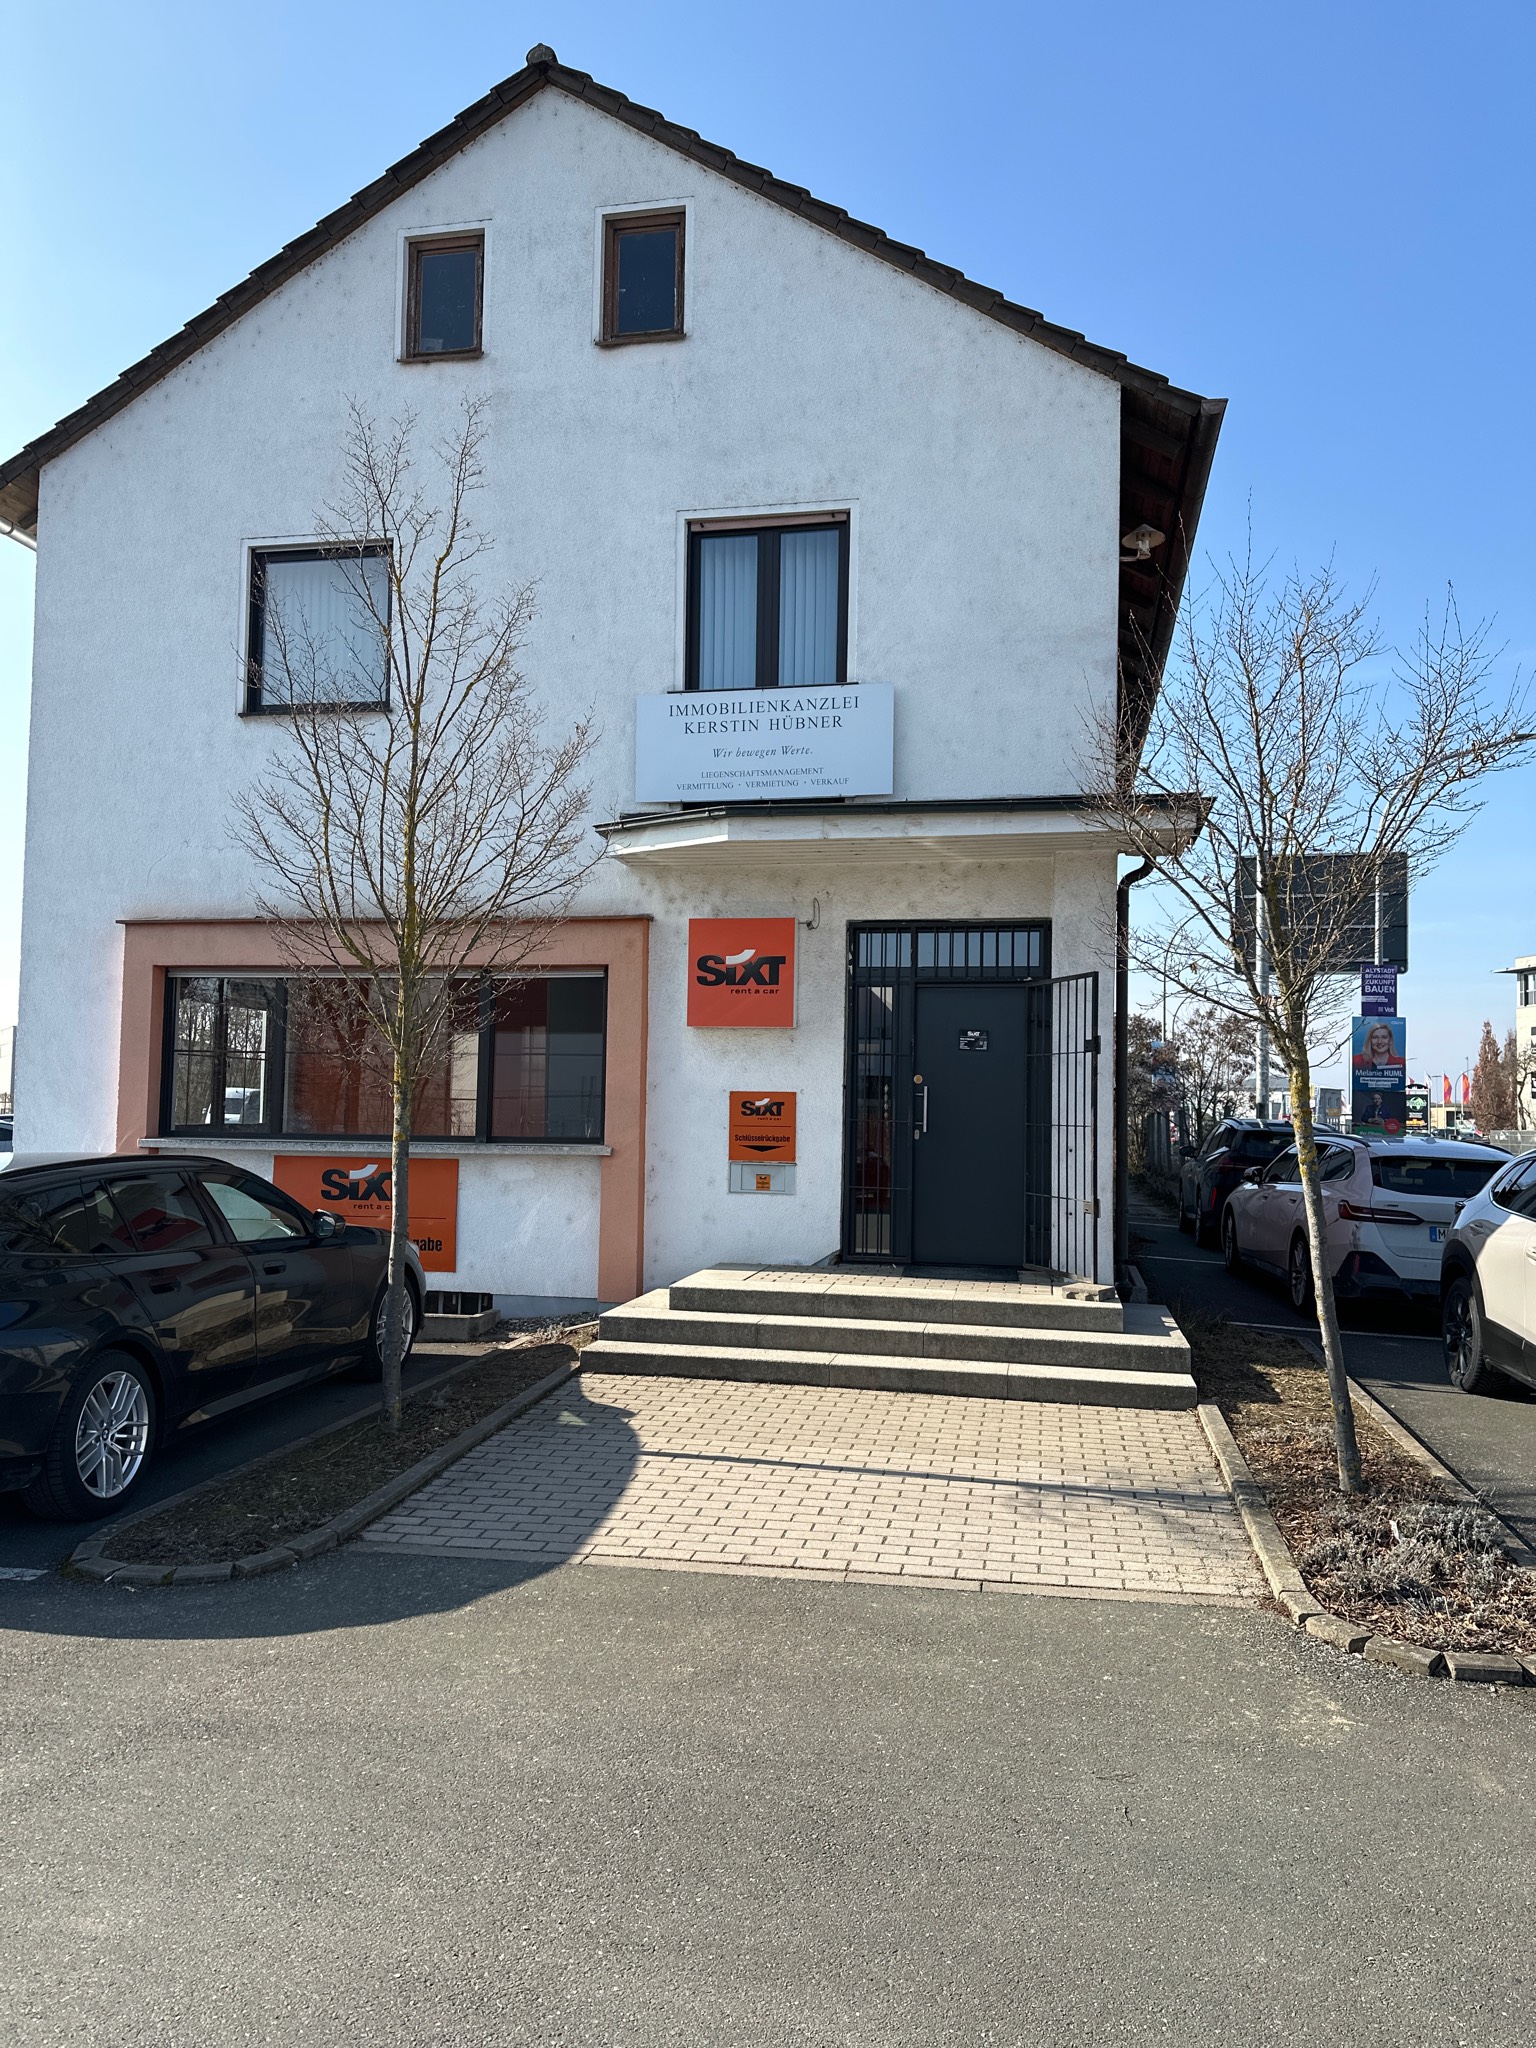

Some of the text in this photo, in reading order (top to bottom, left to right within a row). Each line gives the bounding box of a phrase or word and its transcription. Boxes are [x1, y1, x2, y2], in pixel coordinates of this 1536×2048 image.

[669, 695, 860, 717] IMMOBILIENKANZLEI
[684, 714, 844, 735] KERSTIN HÜBNER
[713, 745, 813, 759] Wir bewegen Werte.
[701, 767, 824, 779] LIEGENSCHAFTSMANAGEMENT
[676, 777, 850, 791] VERMITTLUNG VERMIETUNG VERKAUF
[730, 987, 752, 995] rent
[1365, 985, 1395, 993] BAUEN
[1355, 1069, 1404, 1077] Melanie HUML
[734, 1133, 791, 1144] Schlüsselrückgabe
